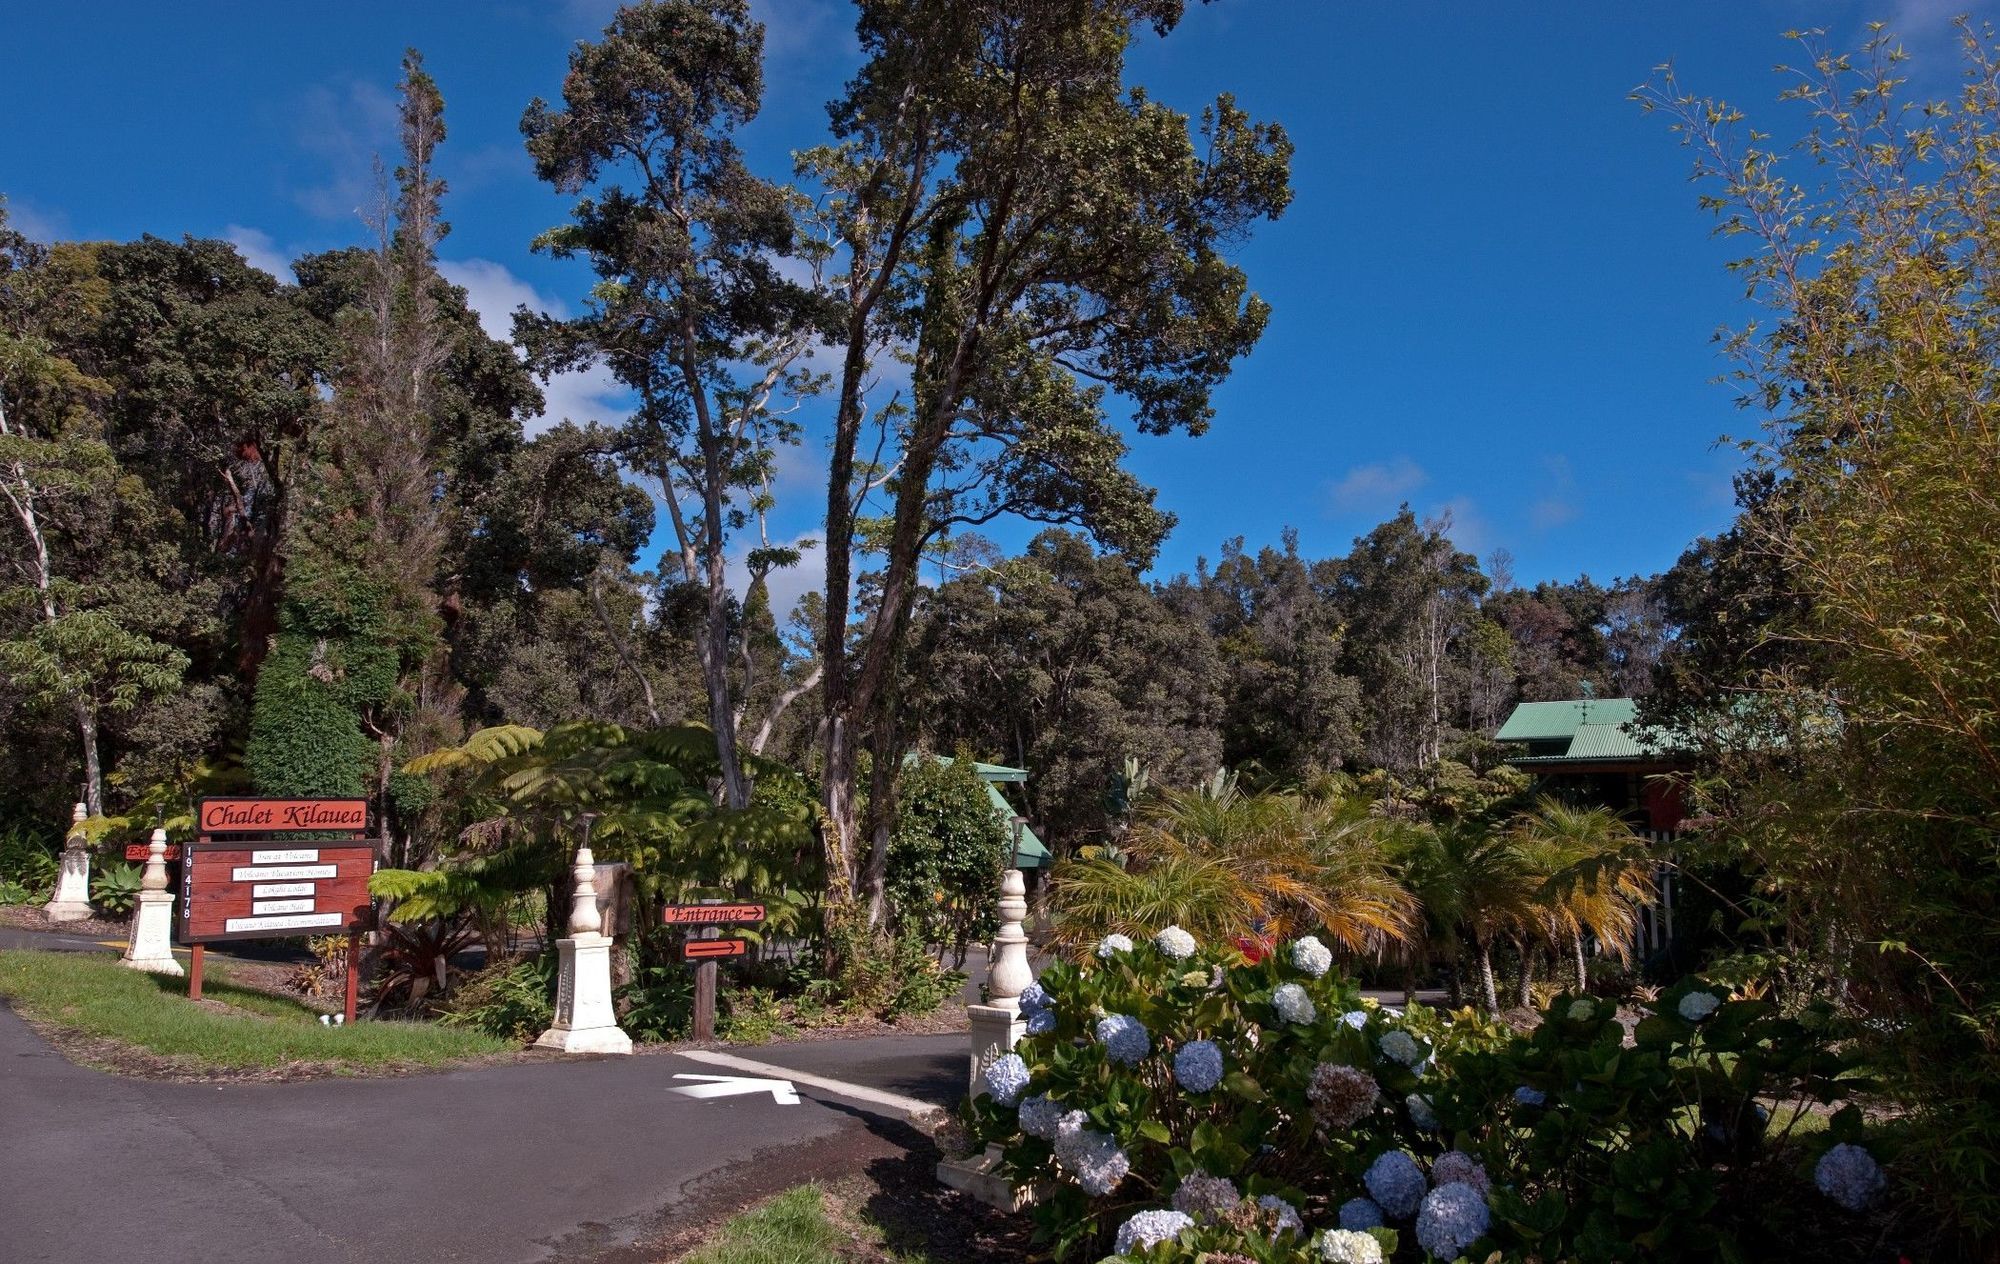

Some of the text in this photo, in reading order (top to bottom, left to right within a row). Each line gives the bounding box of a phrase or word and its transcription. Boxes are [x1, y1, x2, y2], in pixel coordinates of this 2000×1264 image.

[206, 803, 362, 827] Chalet Kilauea
[671, 907, 743, 922] Entrance
